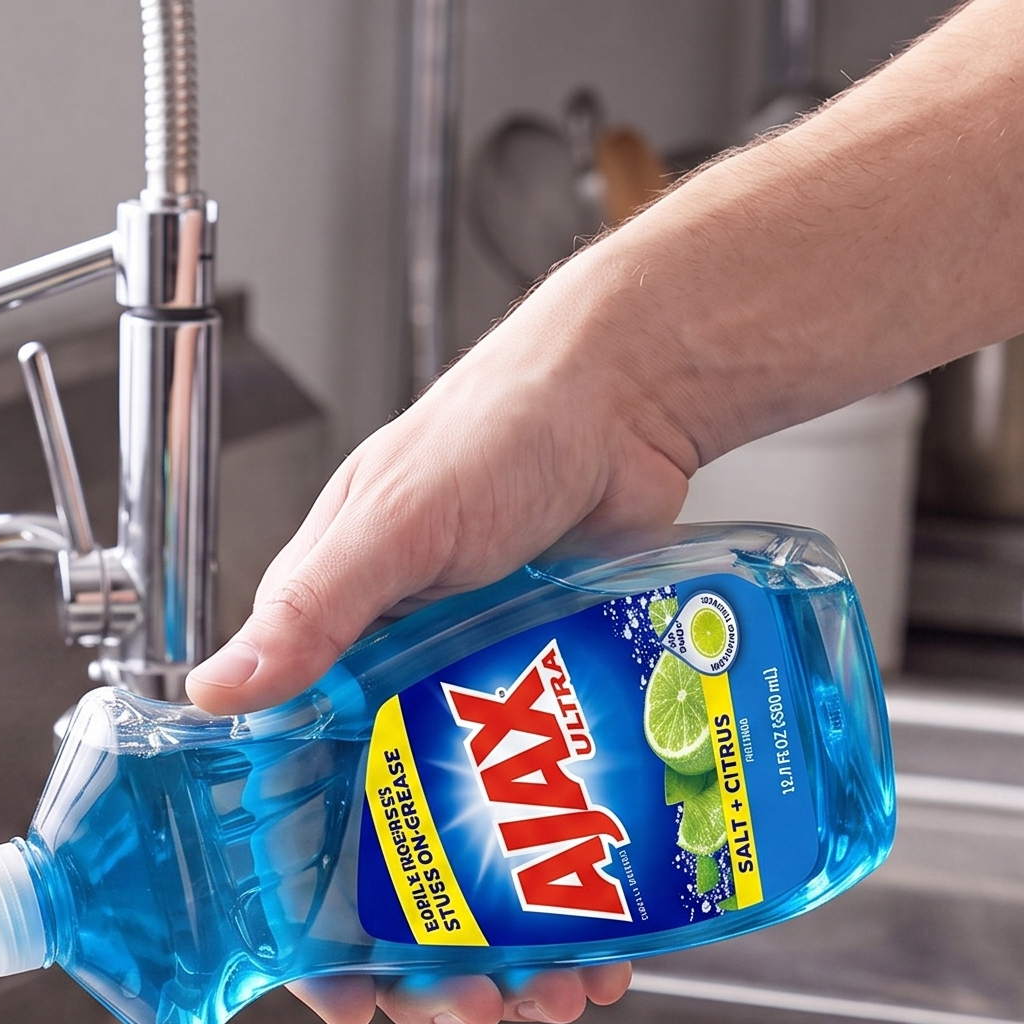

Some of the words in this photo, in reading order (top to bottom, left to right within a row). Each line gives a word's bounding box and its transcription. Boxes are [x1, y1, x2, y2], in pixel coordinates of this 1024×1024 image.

[541, 647, 592, 756] ULTRA
[446, 663, 627, 917] AJAX
[714, 713, 741, 793] CITRUS
[731, 799, 743, 812] +
[731, 818, 754, 873] SALT
